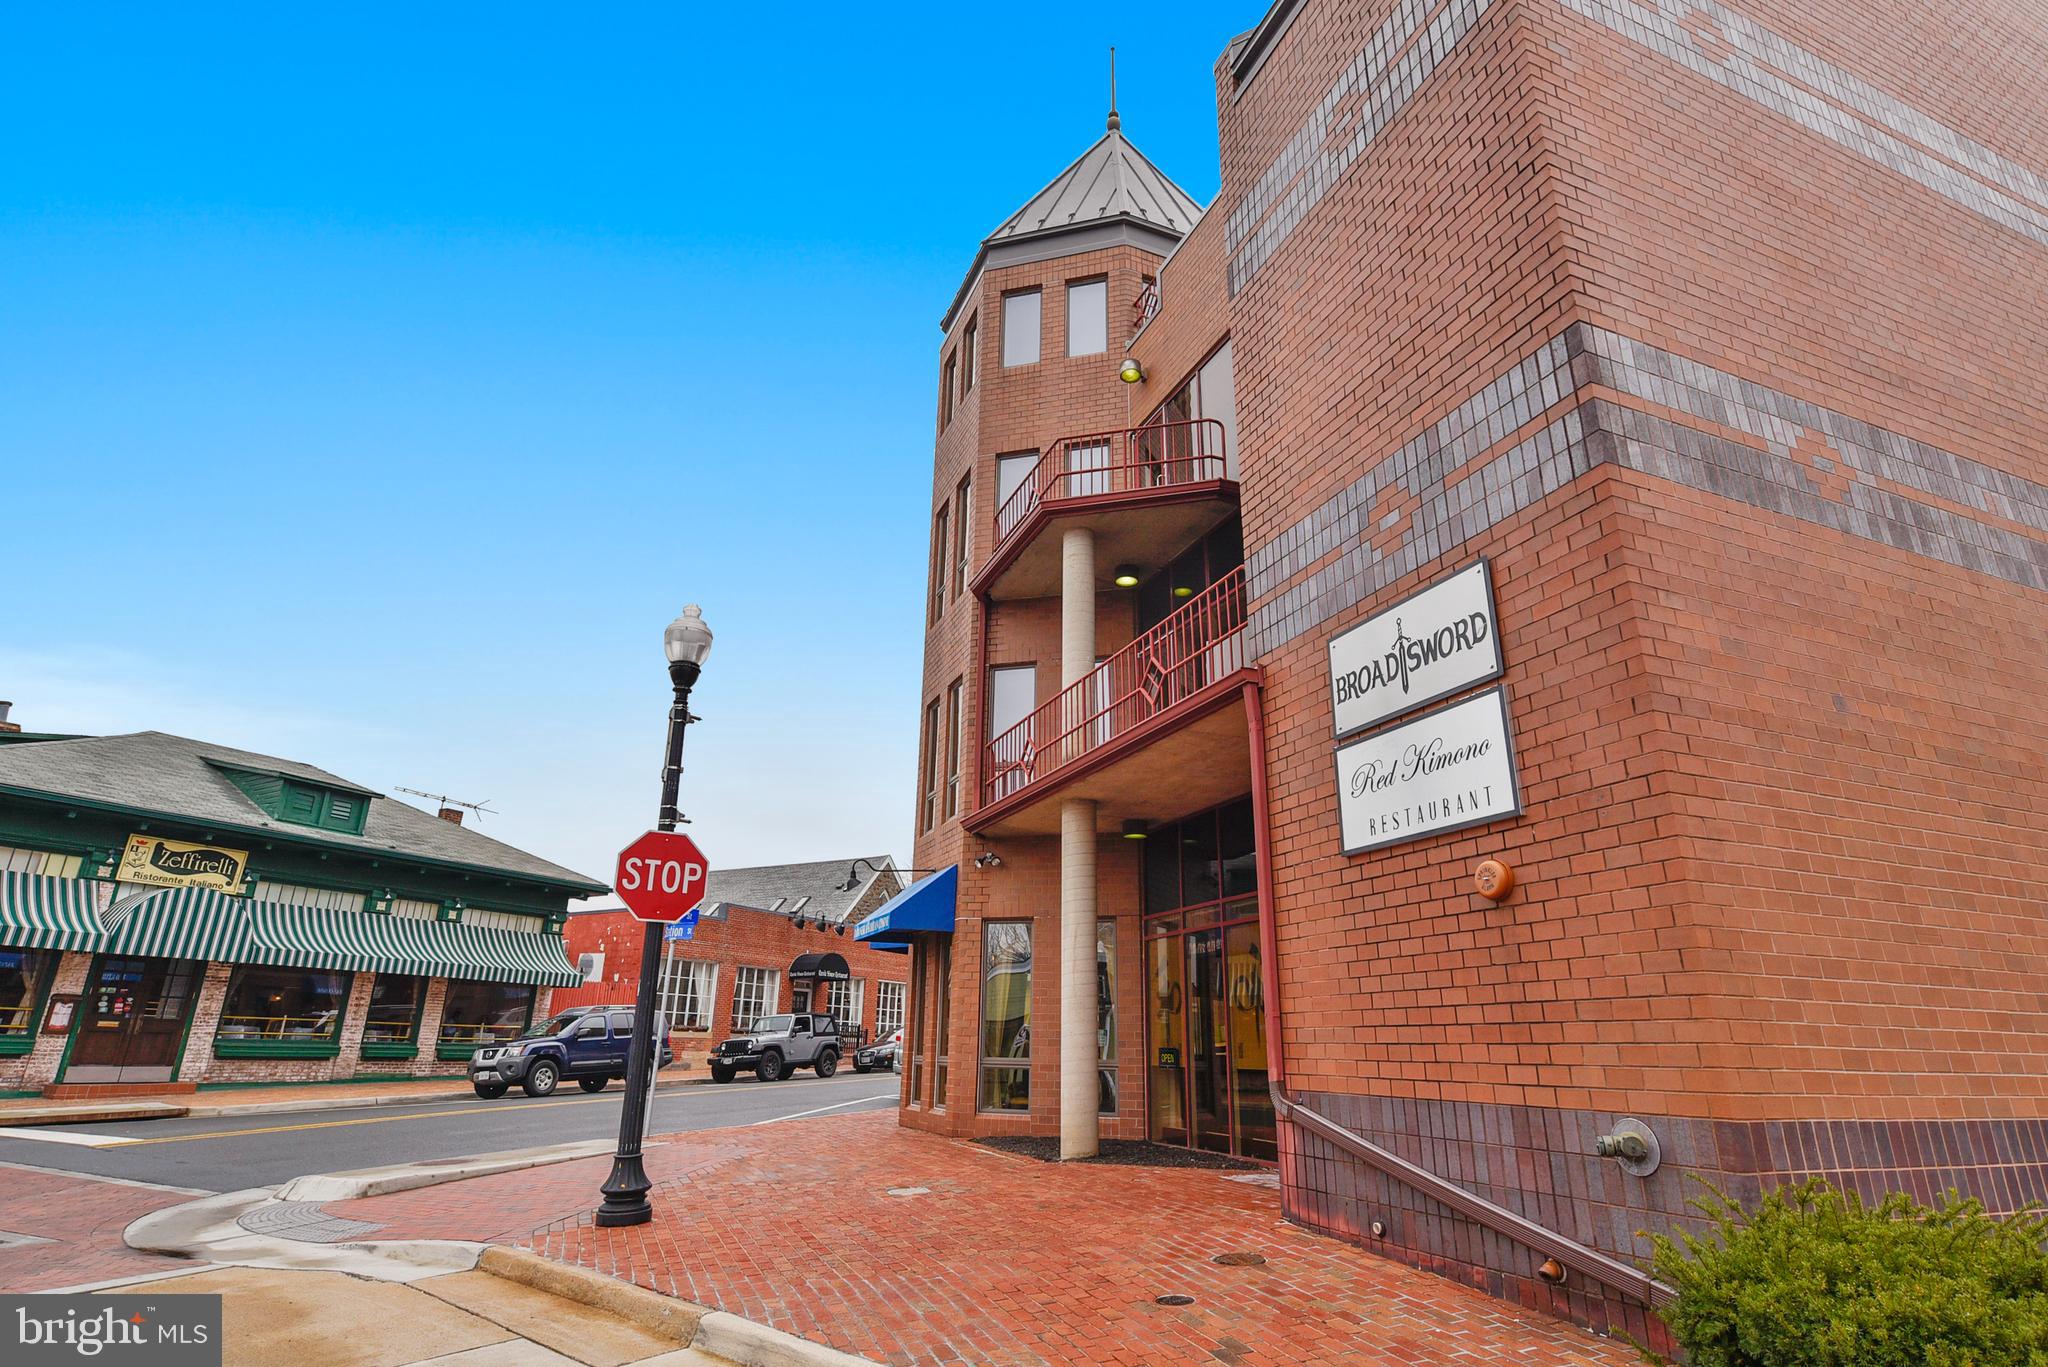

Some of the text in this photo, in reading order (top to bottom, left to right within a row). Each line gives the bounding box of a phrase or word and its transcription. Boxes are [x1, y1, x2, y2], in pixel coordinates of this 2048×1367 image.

[1351, 737, 1492, 798] Red Kimono
[1369, 785, 1493, 836] RESTAURANT
[158, 849, 234, 875] Zeffirelli
[621, 857, 702, 894] STOP
[132, 871, 224, 890] Ristorante Italiano
[1161, 1053, 1175, 1063] OPEN
